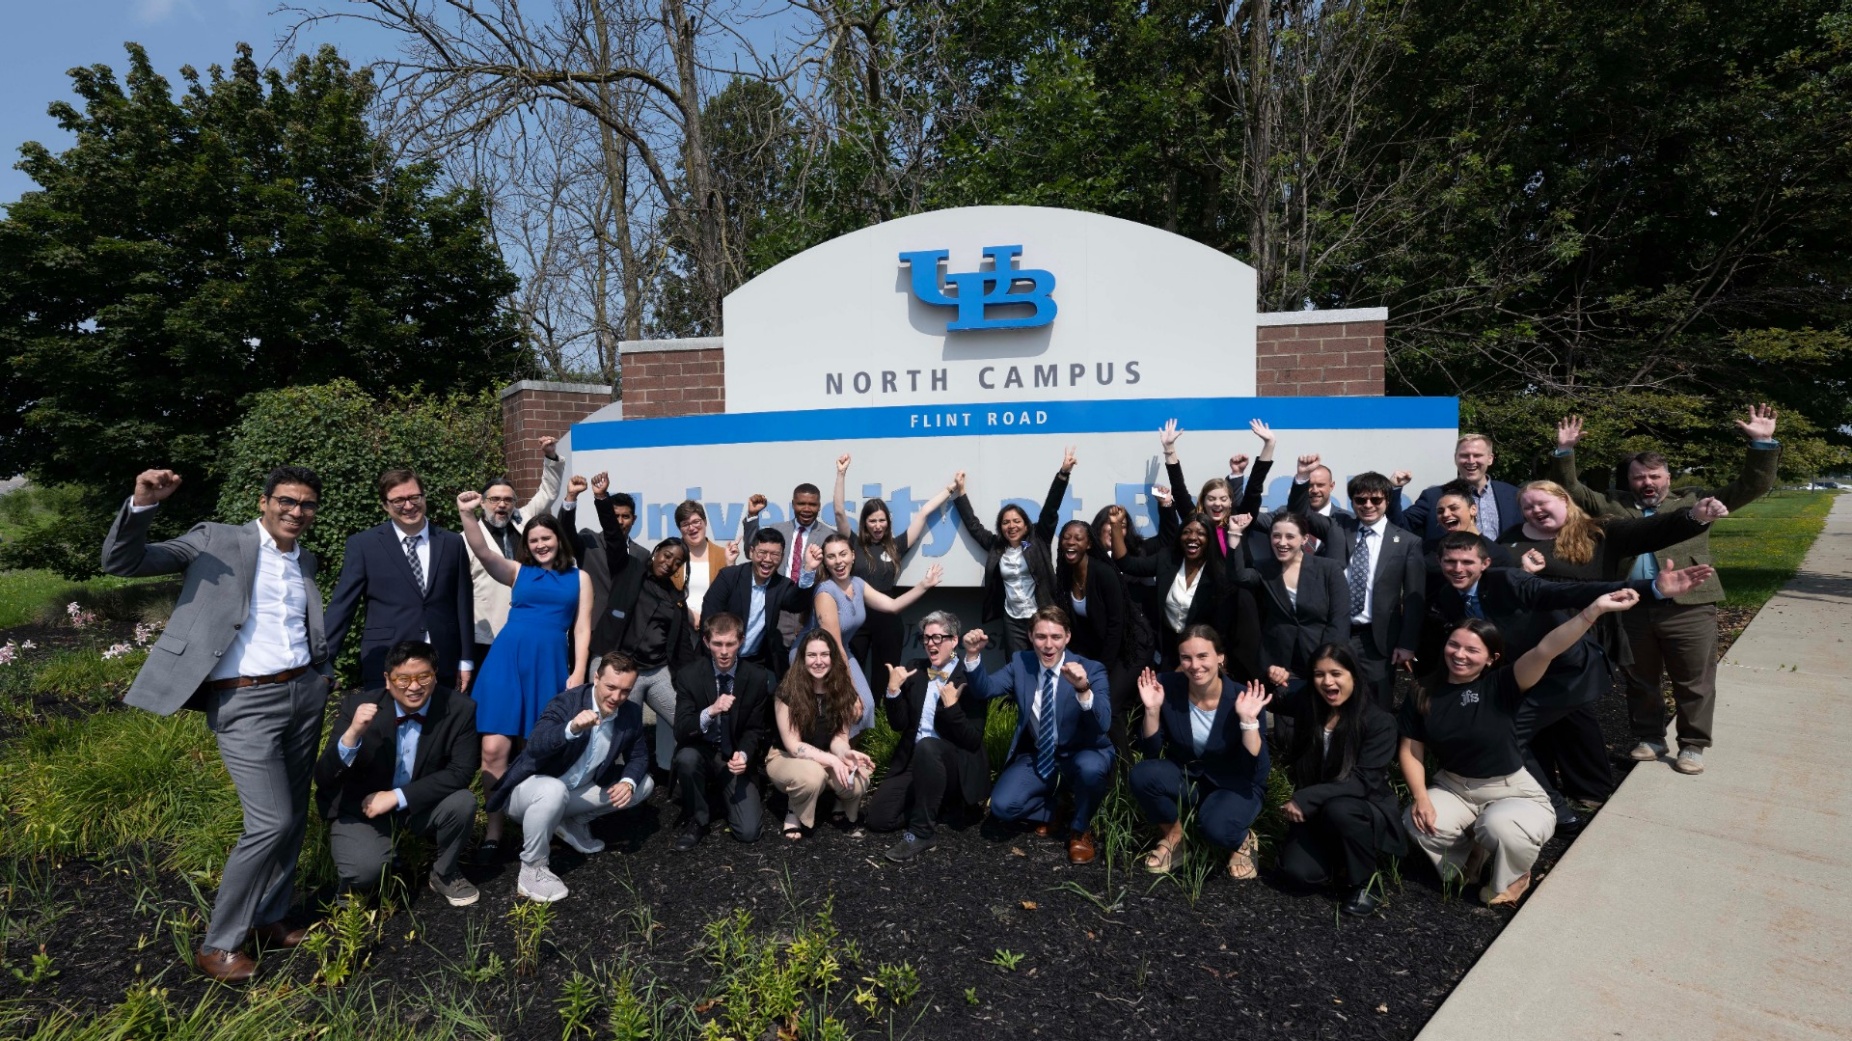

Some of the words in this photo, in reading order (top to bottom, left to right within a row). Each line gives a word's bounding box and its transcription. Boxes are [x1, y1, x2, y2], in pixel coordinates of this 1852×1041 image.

[899, 245, 1057, 332] UB
[826, 368, 948, 394] NORTH
[978, 361, 1141, 389] CAMPUS
[910, 413, 971, 428] FLINT
[987, 411, 1048, 426] ROAD
